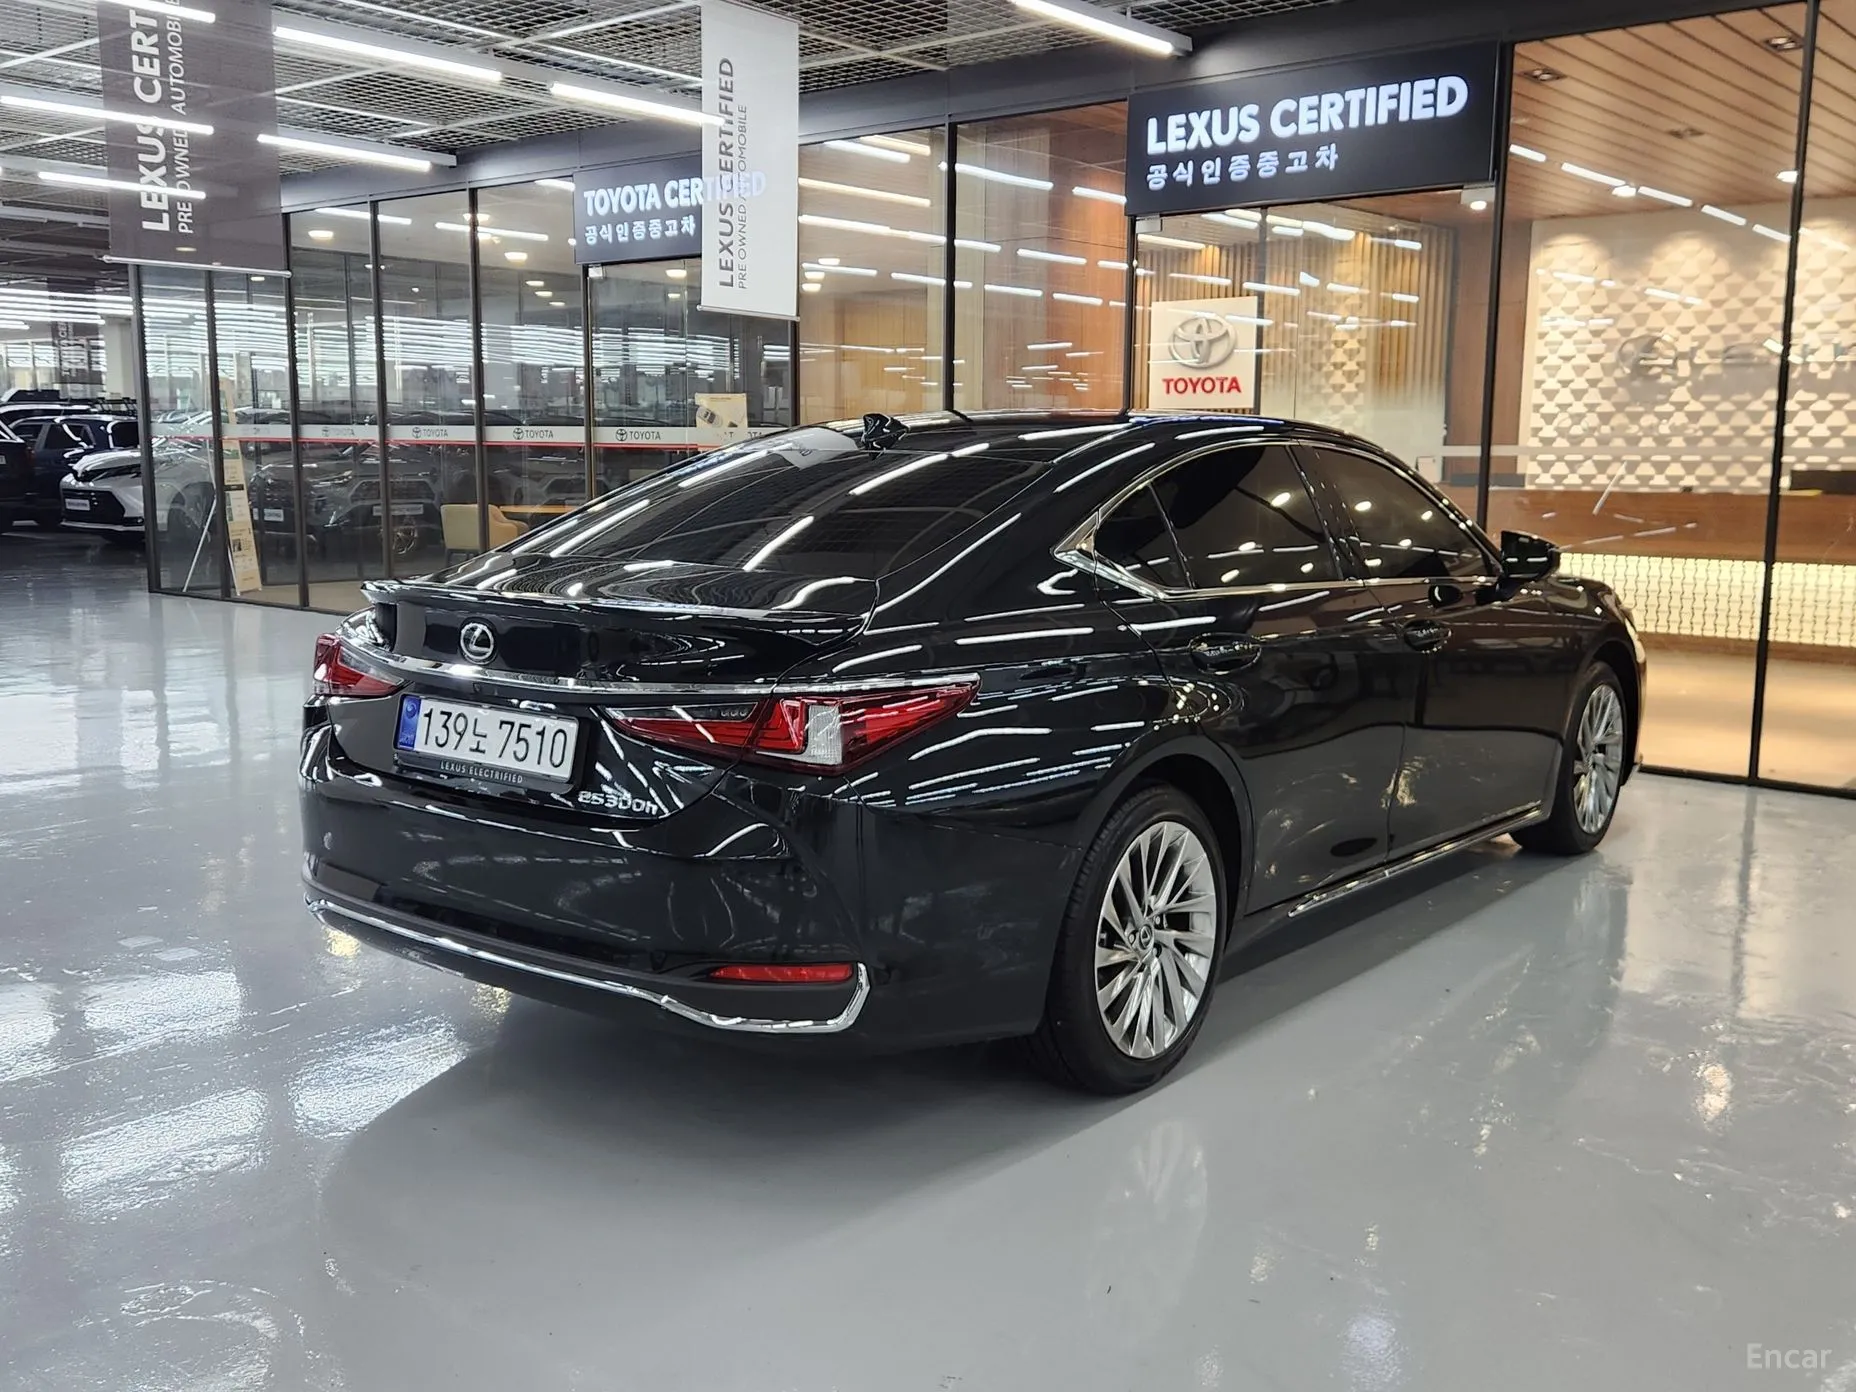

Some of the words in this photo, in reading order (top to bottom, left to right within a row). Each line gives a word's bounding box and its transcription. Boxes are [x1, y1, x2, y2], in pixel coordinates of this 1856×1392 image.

[165, 0, 187, 116] AUTOMOBIE
[718, 57, 734, 193] CERTIFIED
[1146, 103, 1261, 155] LEXUS
[1269, 75, 1469, 138] CERTIFIED
[136, 116, 170, 231] LEXUS
[1146, 143, 1340, 191] 공식인증중고차
[583, 183, 662, 217] TOYOTA
[177, 201, 194, 234] PRE
[584, 214, 697, 246] 공식인증중고차
[738, 204, 747, 260] OWNED
[718, 202, 734, 288] LEXUS
[738, 263, 747, 290] PRE
[1162, 375, 1242, 395] TOYOTA
[422, 428, 449, 438] TOYOTA
[525, 429, 554, 440] TOYOTA
[629, 430, 662, 441] TOYOTA
[423, 708, 488, 754] 139노
[498, 719, 568, 768] 7510
[440, 761, 466, 774] LEXUS
[469, 766, 524, 784] ELECTRIFIED
